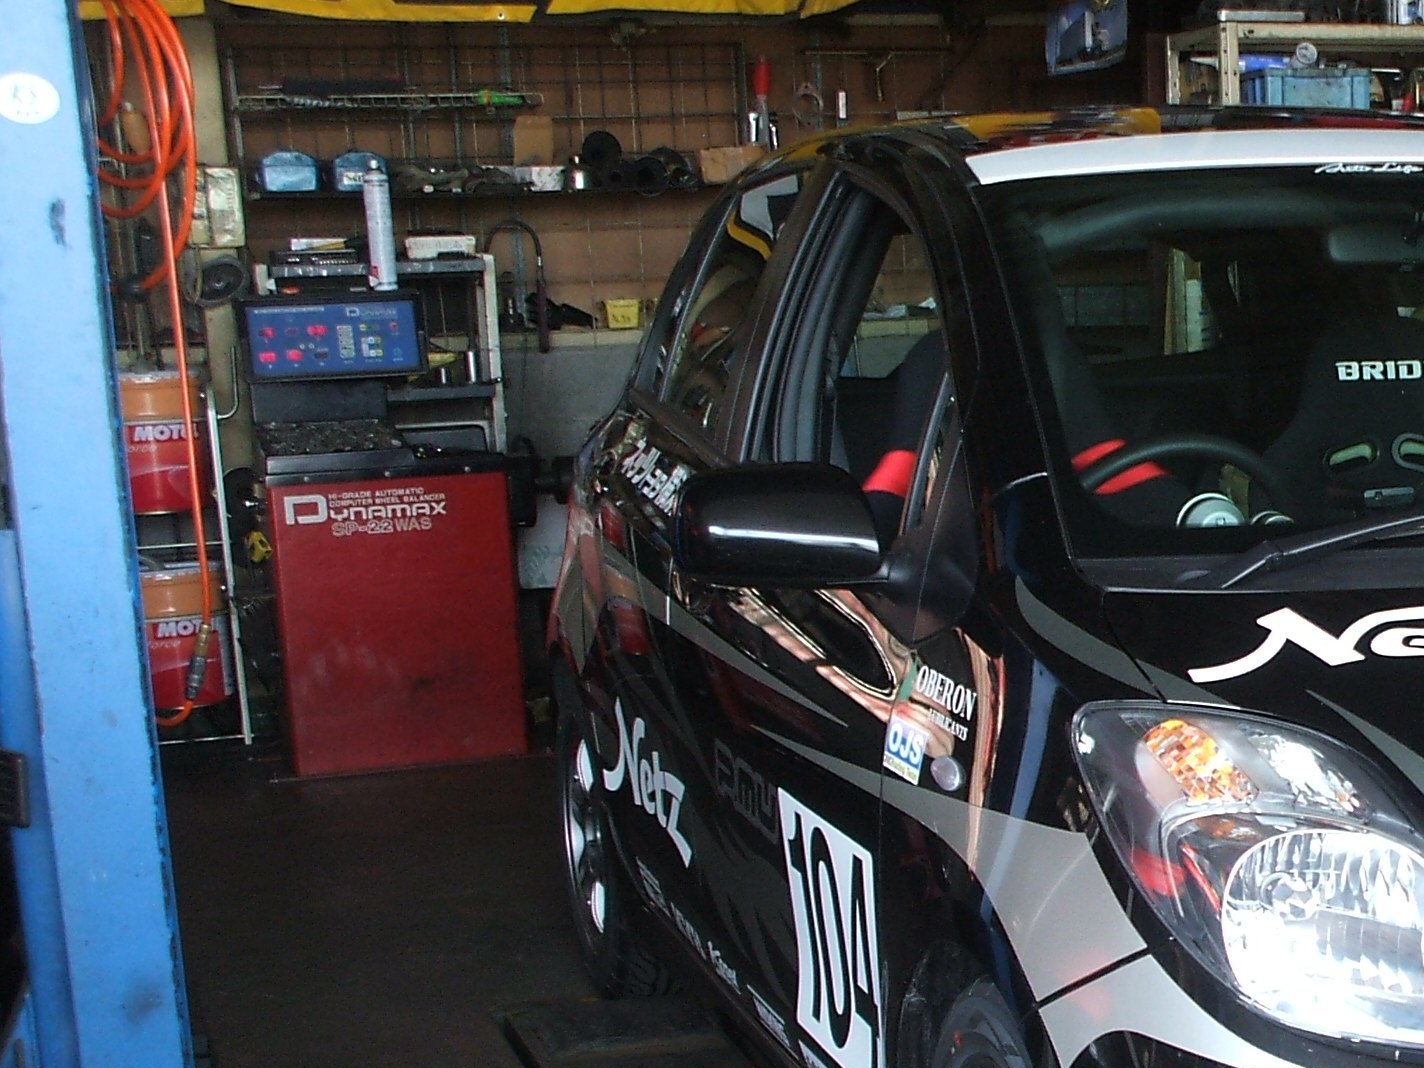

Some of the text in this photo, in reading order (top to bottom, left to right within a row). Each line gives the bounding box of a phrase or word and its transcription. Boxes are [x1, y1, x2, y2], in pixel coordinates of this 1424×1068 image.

[329, 493, 446, 508] COMPUTER WHEEL BALANCER
[374, 487, 425, 498] AUTOMATIC
[916, 665, 977, 721] OBERON
[888, 721, 925, 766] OJS
[602, 695, 693, 868] Netz
